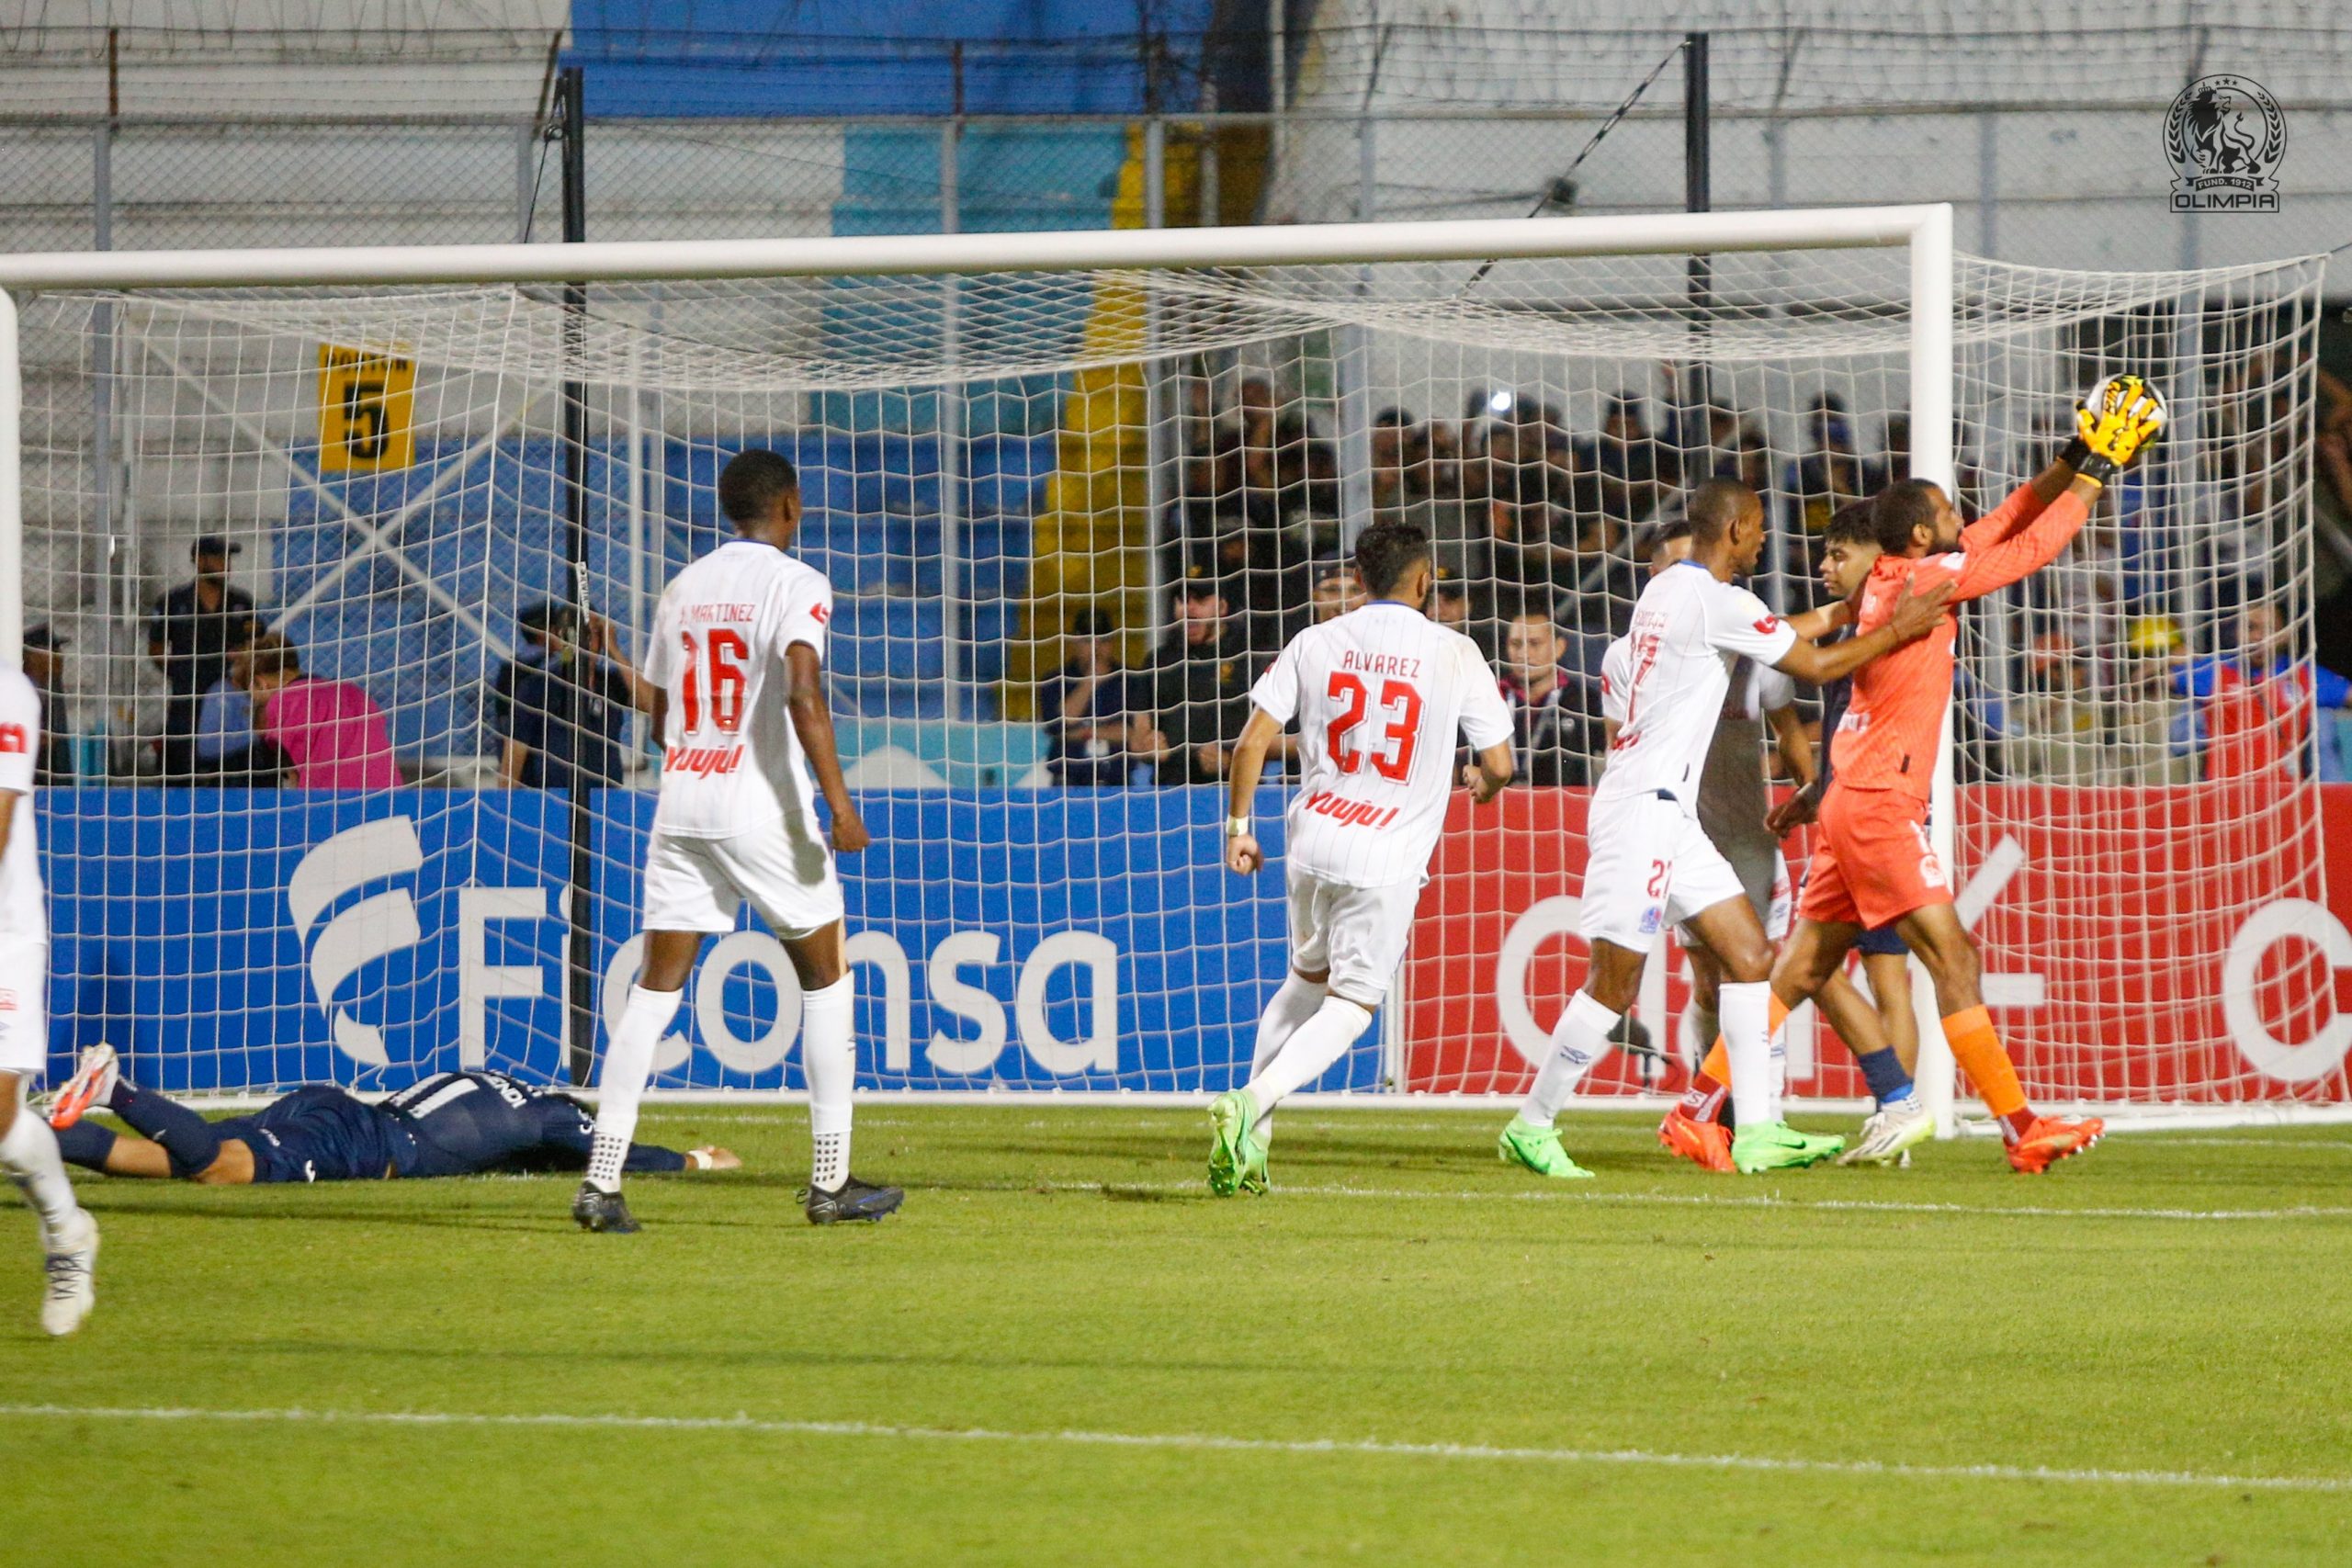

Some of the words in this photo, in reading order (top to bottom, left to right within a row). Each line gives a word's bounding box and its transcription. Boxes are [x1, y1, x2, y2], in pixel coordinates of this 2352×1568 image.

[344, 381, 390, 459] 5
[691, 604, 756, 623] MARTINEZ
[682, 627, 750, 736] 16
[1342, 649, 1420, 679] ALVAREZ
[1326, 671, 1425, 786] 23
